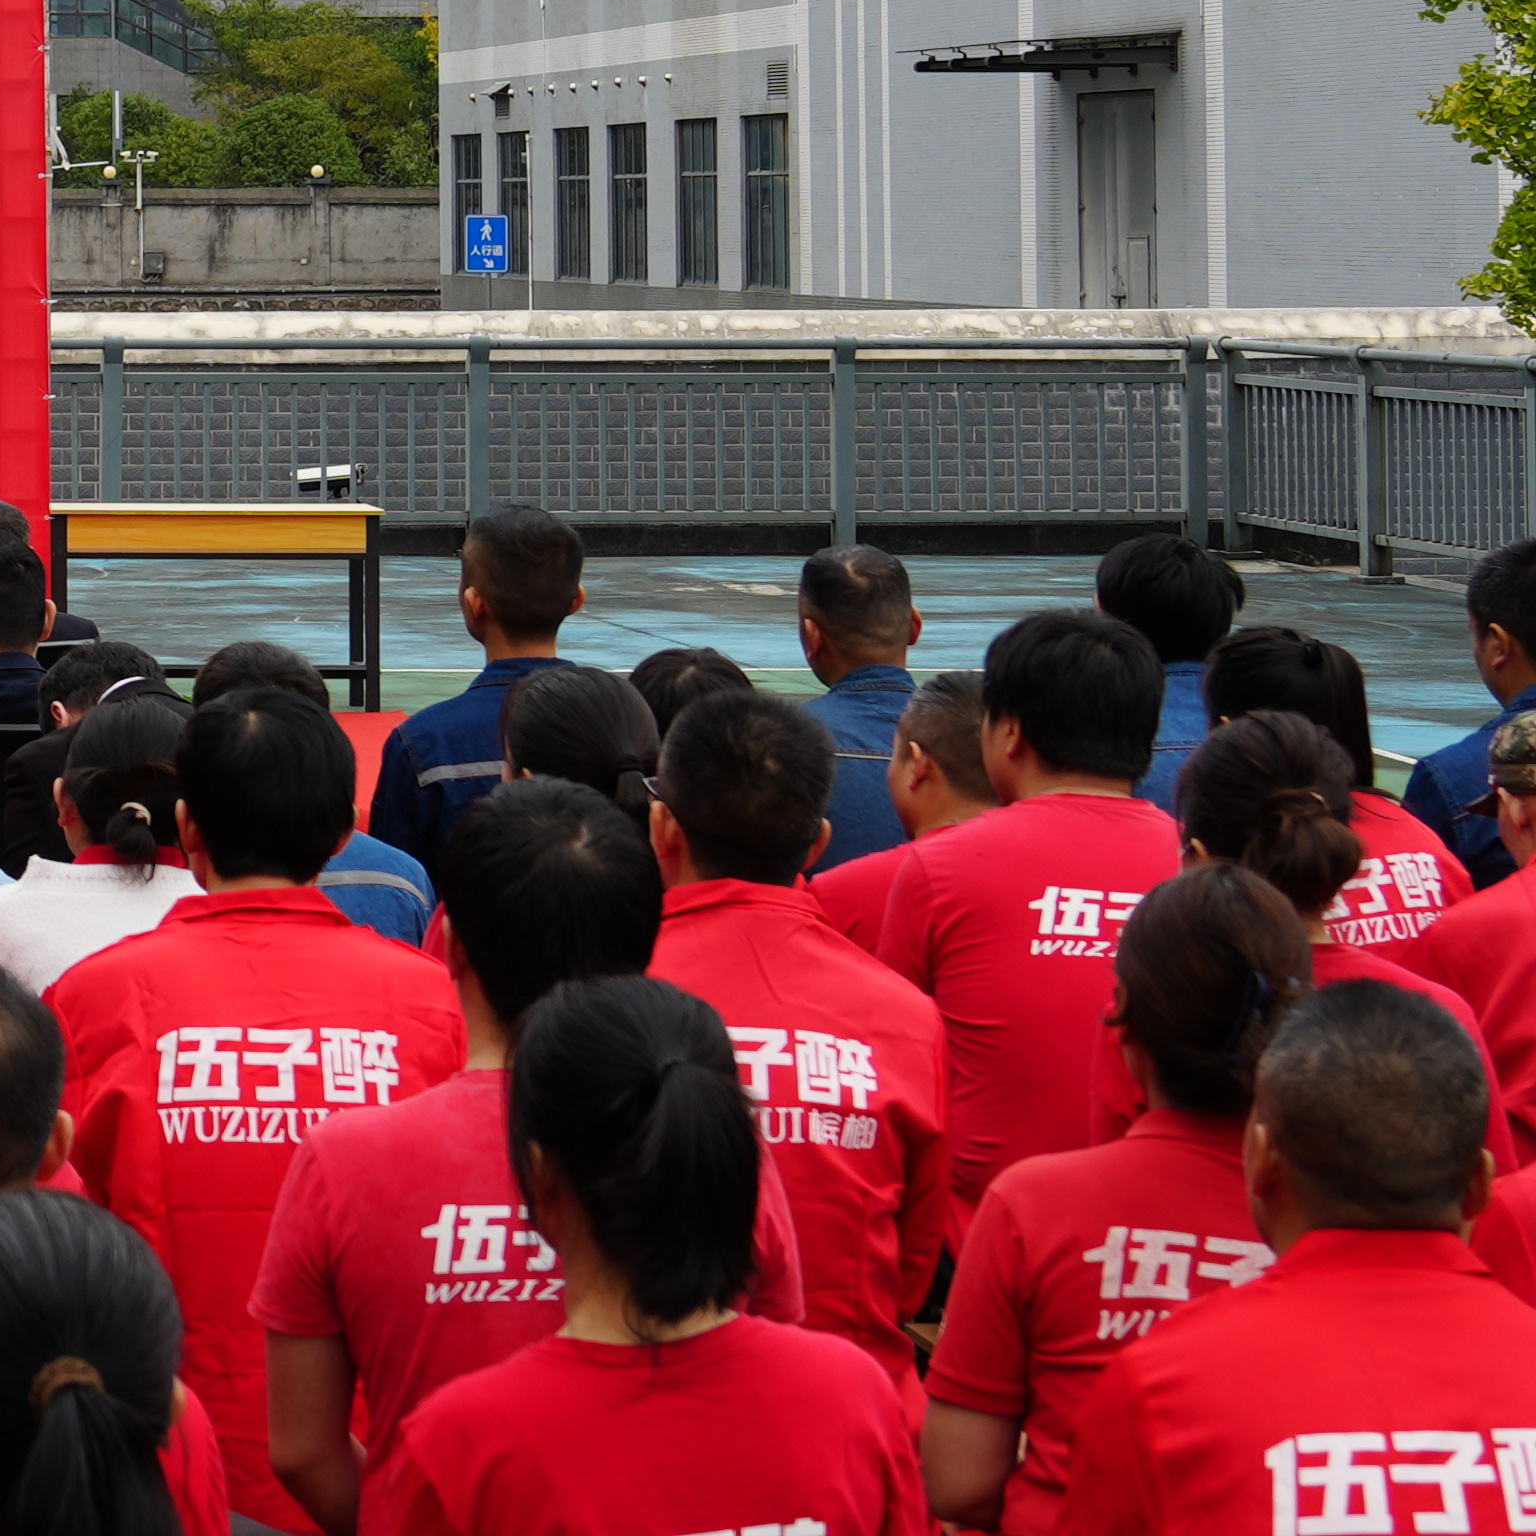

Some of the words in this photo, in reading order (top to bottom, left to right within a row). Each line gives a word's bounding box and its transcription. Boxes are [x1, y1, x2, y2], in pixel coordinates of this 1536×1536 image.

[470, 244, 503, 256] 人行道
[156, 1026, 400, 1106] 伍子醉
